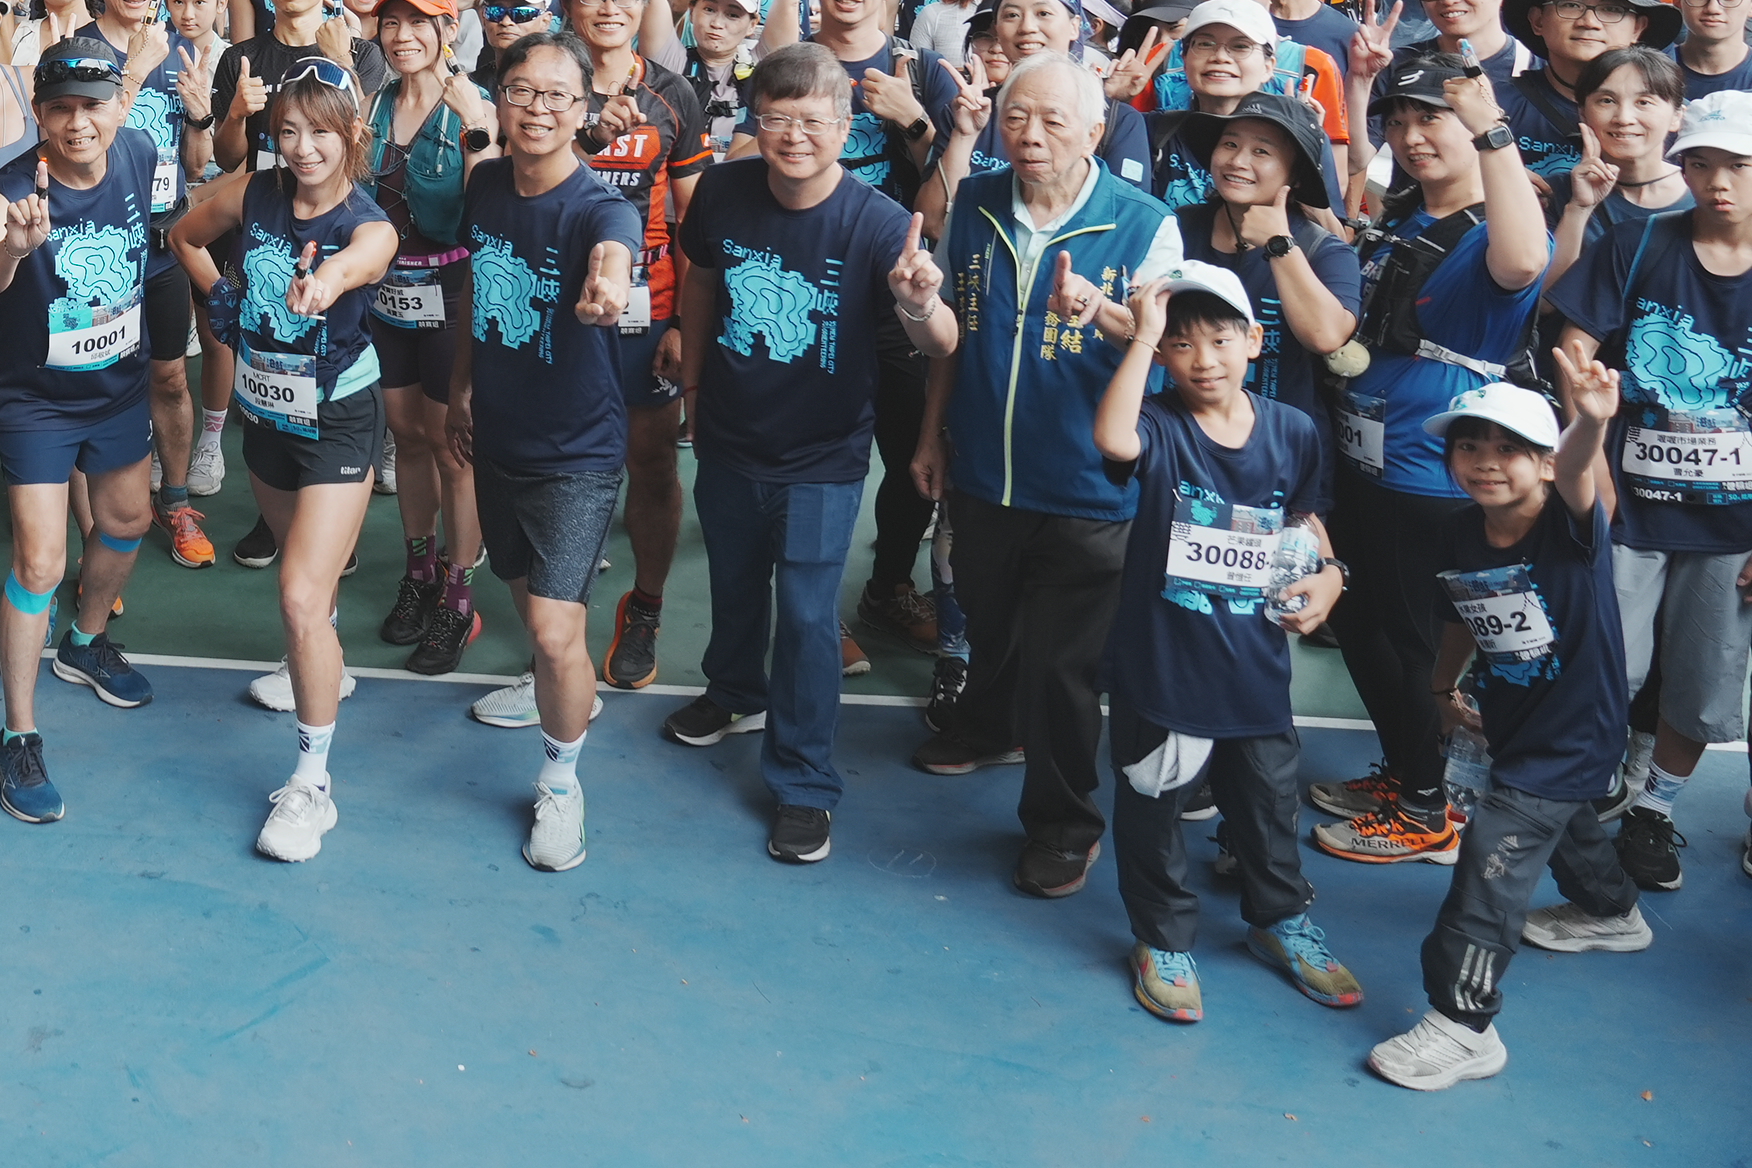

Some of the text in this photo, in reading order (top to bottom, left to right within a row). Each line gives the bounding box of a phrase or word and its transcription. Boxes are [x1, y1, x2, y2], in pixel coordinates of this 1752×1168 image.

[1518, 136, 1578, 154] Sanxi
[970, 150, 1011, 171] Sanx
[250, 221, 293, 253] Sanxia
[471, 223, 514, 253] Sanxia
[723, 238, 782, 268] Sanxia
[1636, 297, 1695, 328] anxia
[71, 325, 126, 354] 10001
[1040, 310, 1061, 361] 務團隊
[242, 373, 295, 403] 10030
[1634, 441, 1743, 467] 30047-1
[1186, 541, 1270, 570] 30088-
[1468, 611, 1532, 637] 089-2
[1351, 835, 1427, 851] MERRELL
